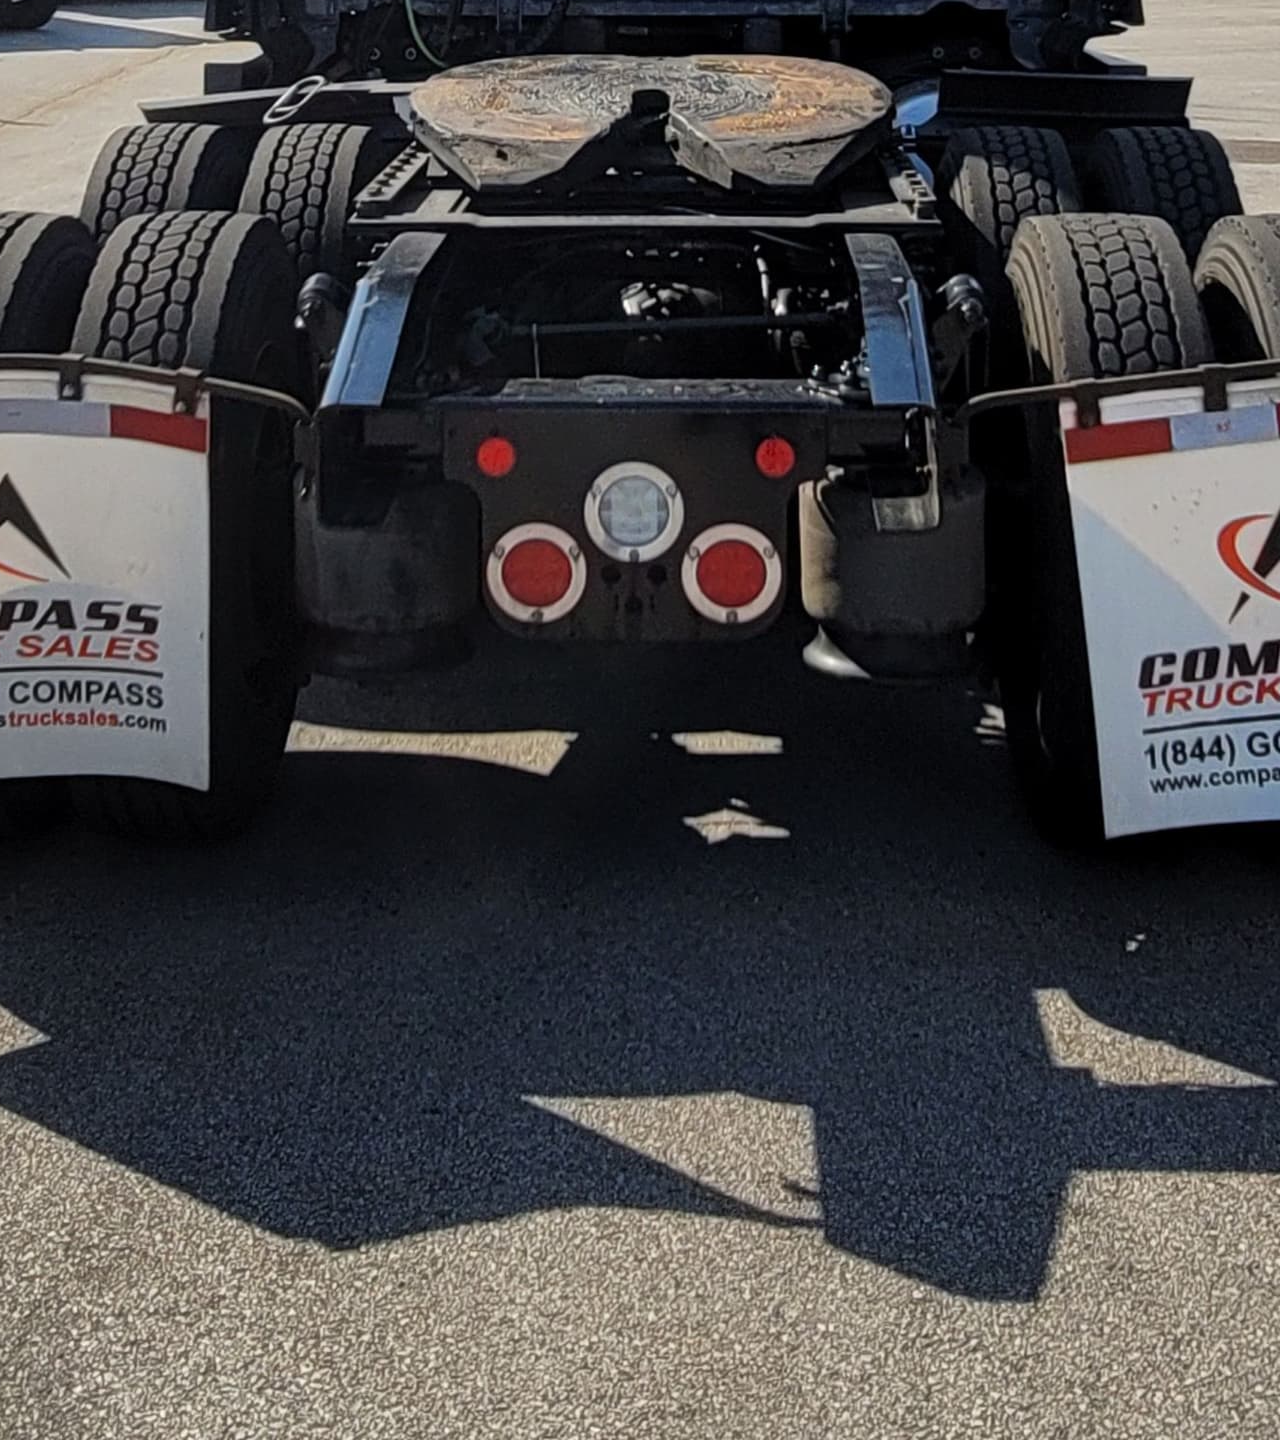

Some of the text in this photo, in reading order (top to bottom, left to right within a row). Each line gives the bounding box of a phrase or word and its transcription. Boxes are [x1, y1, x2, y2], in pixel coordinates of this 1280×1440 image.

[16, 633, 161, 664] SALES
[8, 678, 165, 709] COMPASS
[1143, 731, 1237, 775] 1(844)
